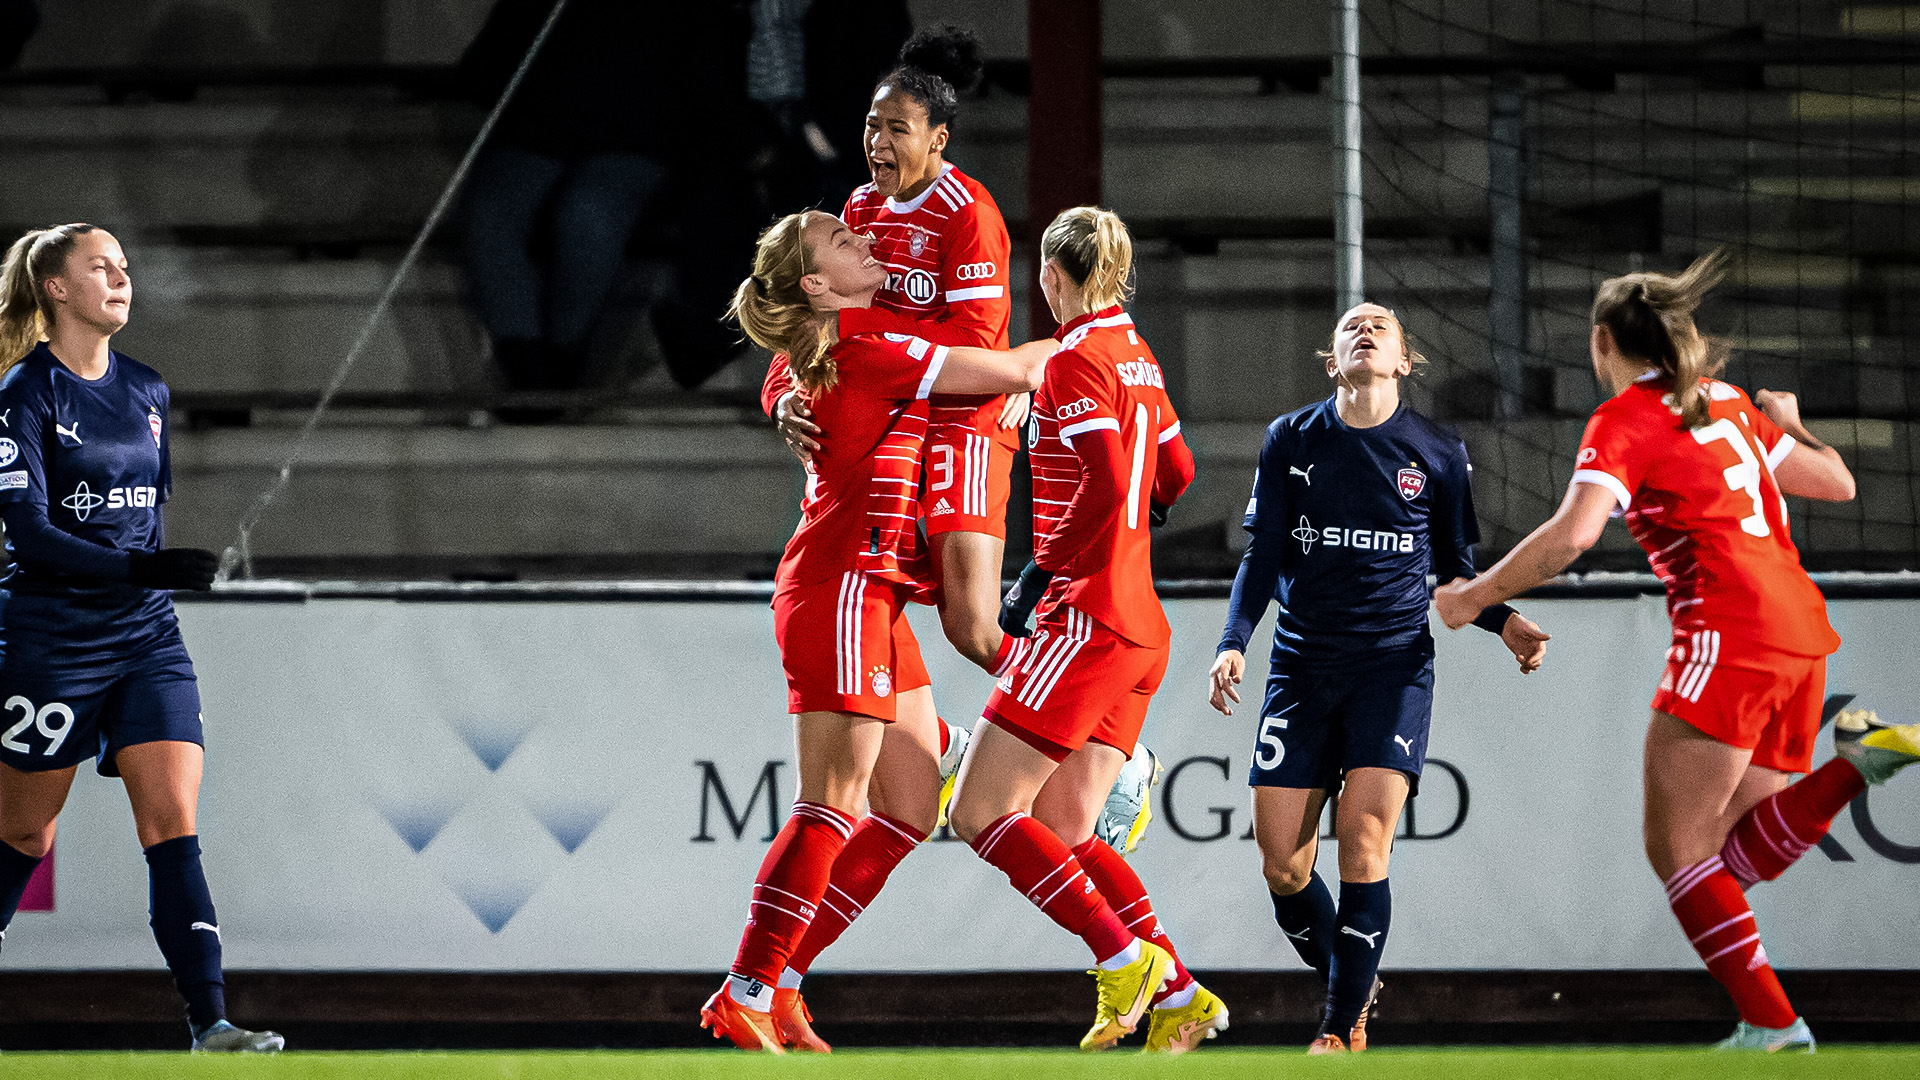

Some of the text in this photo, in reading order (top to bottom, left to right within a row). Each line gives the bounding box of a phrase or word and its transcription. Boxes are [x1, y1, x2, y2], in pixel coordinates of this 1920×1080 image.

[931, 444, 954, 491] 3
[1401, 476, 1421, 488] FCR
[1, 695, 75, 756] 29
